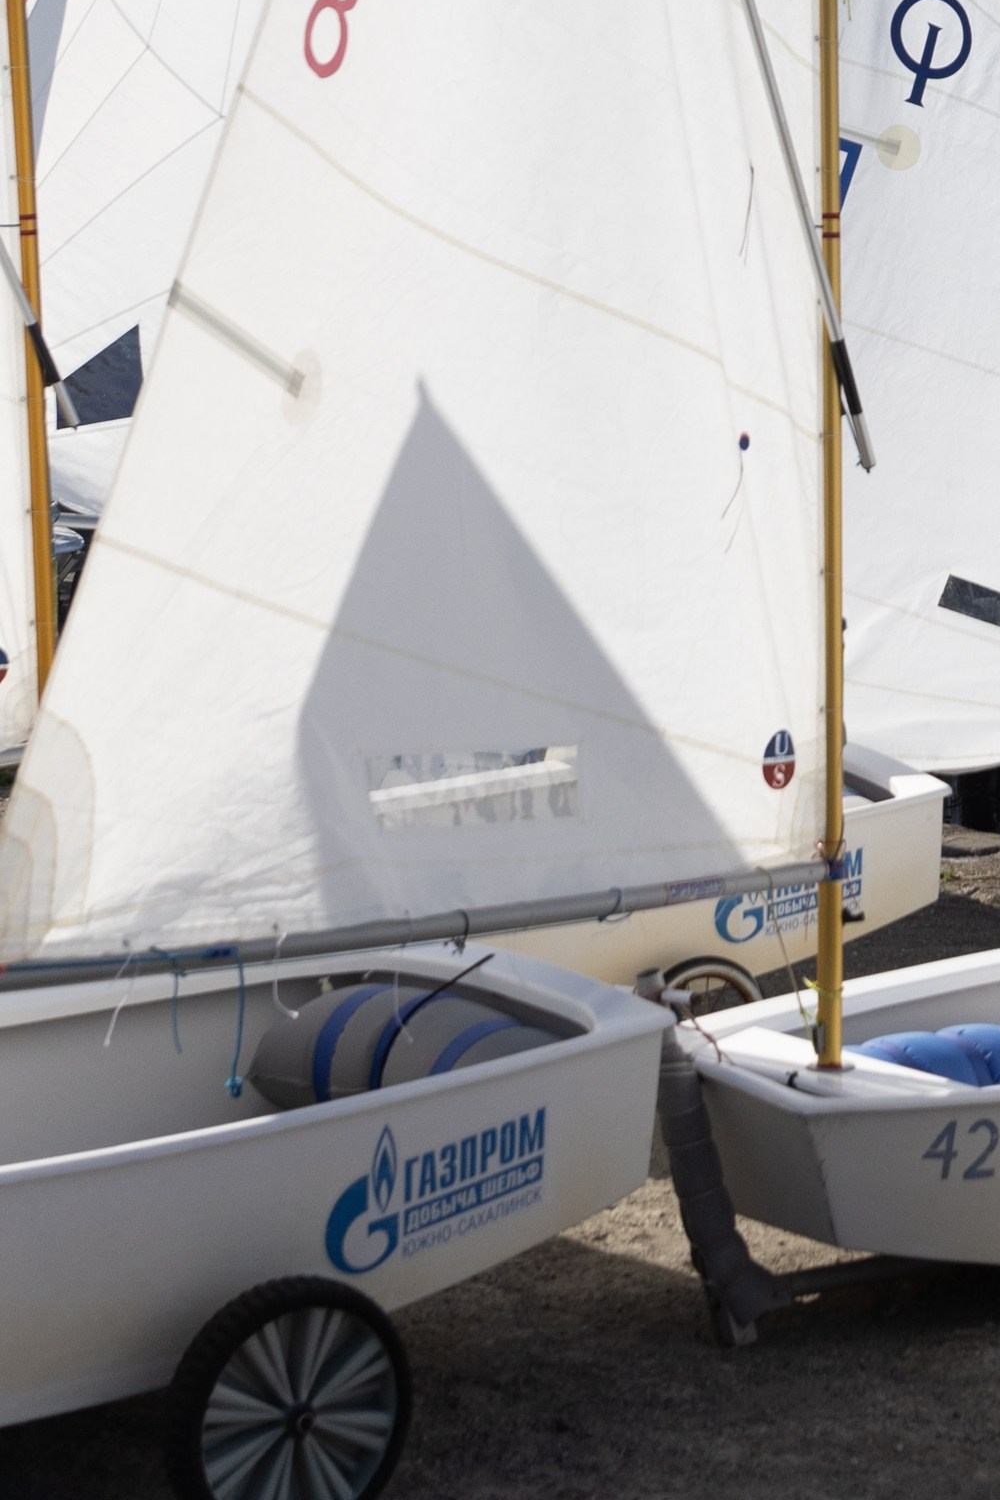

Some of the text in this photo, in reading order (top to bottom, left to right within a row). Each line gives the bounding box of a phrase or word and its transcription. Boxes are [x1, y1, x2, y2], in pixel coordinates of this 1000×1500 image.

[404, 1106, 546, 1203] ГАЗПРОМ
[922, 1118, 1000, 1181] 42
[406, 1160, 541, 1233] ДОБЫЧА ШЕЛЬФ
